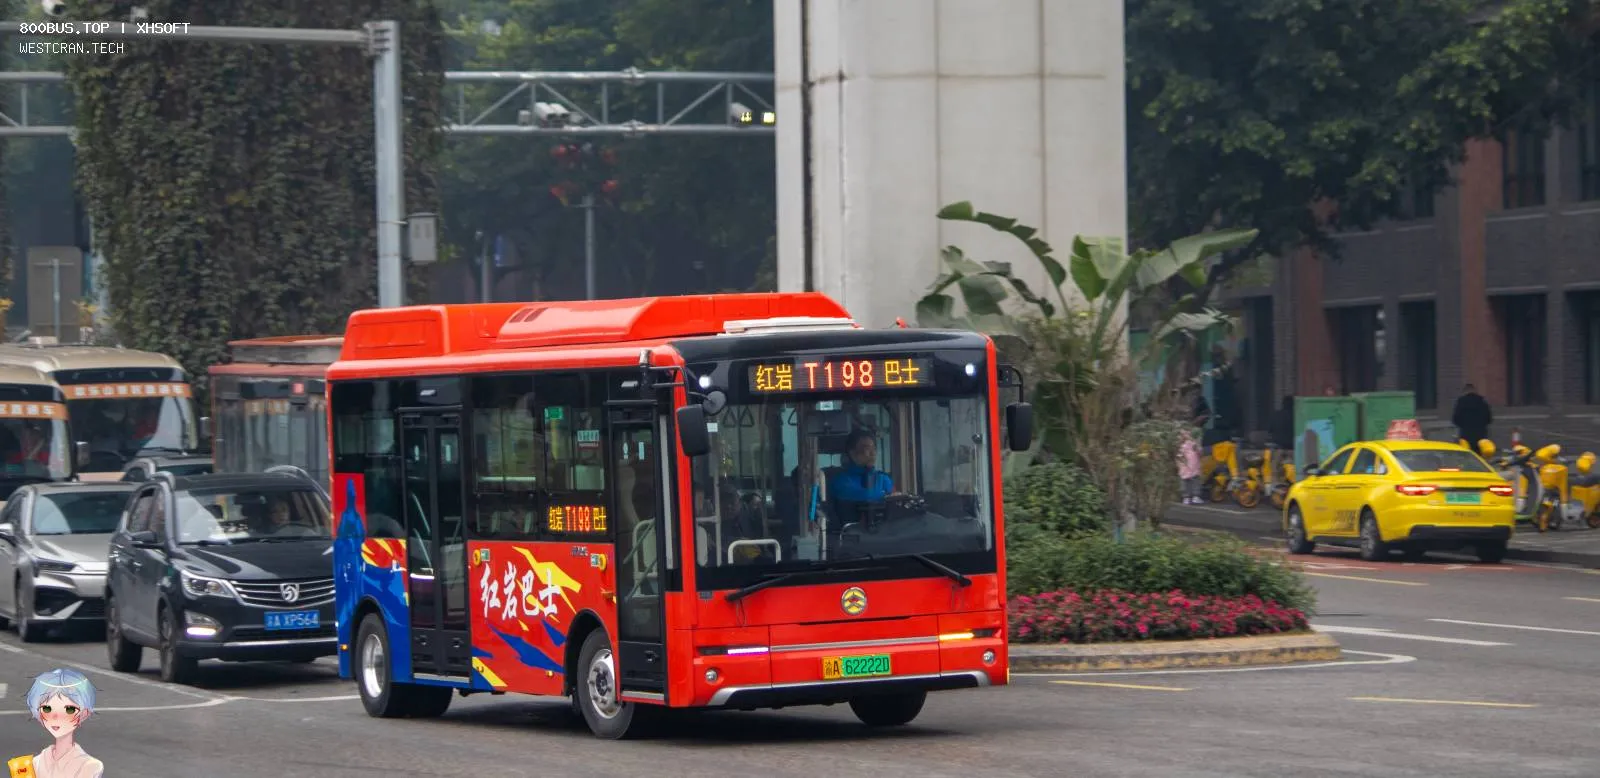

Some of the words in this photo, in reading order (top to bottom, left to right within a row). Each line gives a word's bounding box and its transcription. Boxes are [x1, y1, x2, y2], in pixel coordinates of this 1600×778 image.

[756, 363, 792, 391] 红岩
[804, 360, 873, 389] T198
[884, 358, 920, 385] 巴士
[549, 506, 563, 531] 红岩
[565, 506, 591, 532] T198
[593, 506, 607, 531] 巴士
[480, 561, 561, 620] 红岩巴士
